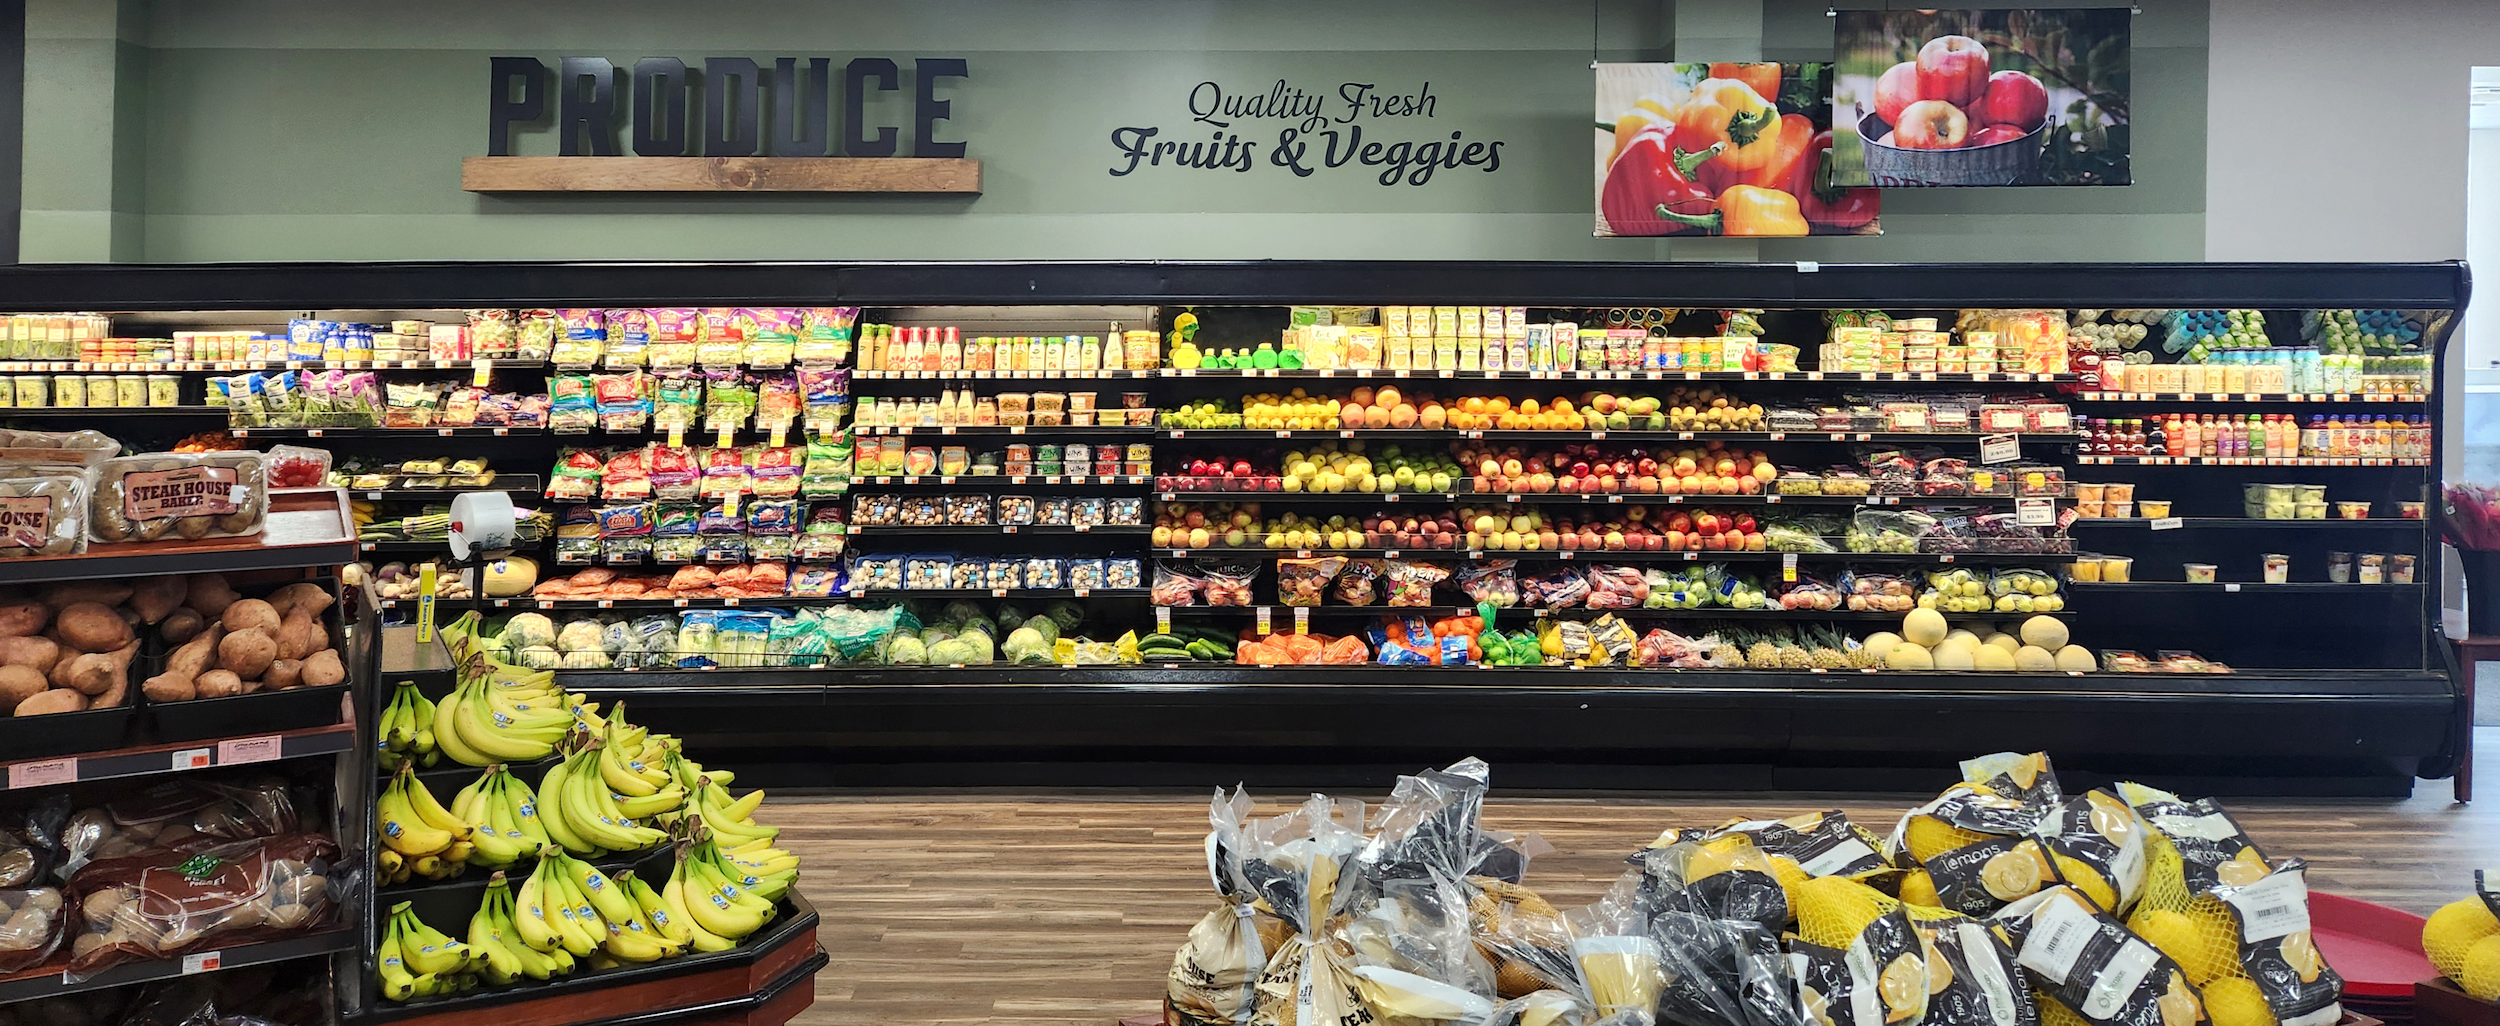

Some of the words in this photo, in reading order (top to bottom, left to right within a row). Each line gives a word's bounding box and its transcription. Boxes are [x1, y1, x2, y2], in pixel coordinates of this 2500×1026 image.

[488, 56, 969, 158] PRODUCE
[1188, 78, 1329, 134] Quality
[1335, 81, 1437, 124] Fresh
[1109, 127, 1257, 177] Fruits
[1270, 127, 1315, 178] &
[1319, 126, 1505, 187] Veggies
[626, 324, 641, 333] Kit
[660, 324, 676, 333] Kit
[710, 318, 725, 327] Kit
[132, 483, 180, 502] STEAK
[185, 481, 233, 497] HOUSE
[0, 512, 43, 528] OUSE
[611, 515, 633, 523] Fresh
[1764, 832, 1784, 842] 1905
[1941, 843, 2001, 872] lemons
[1962, 899, 1986, 911] 1905
[2011, 956, 2037, 1022] lemons
